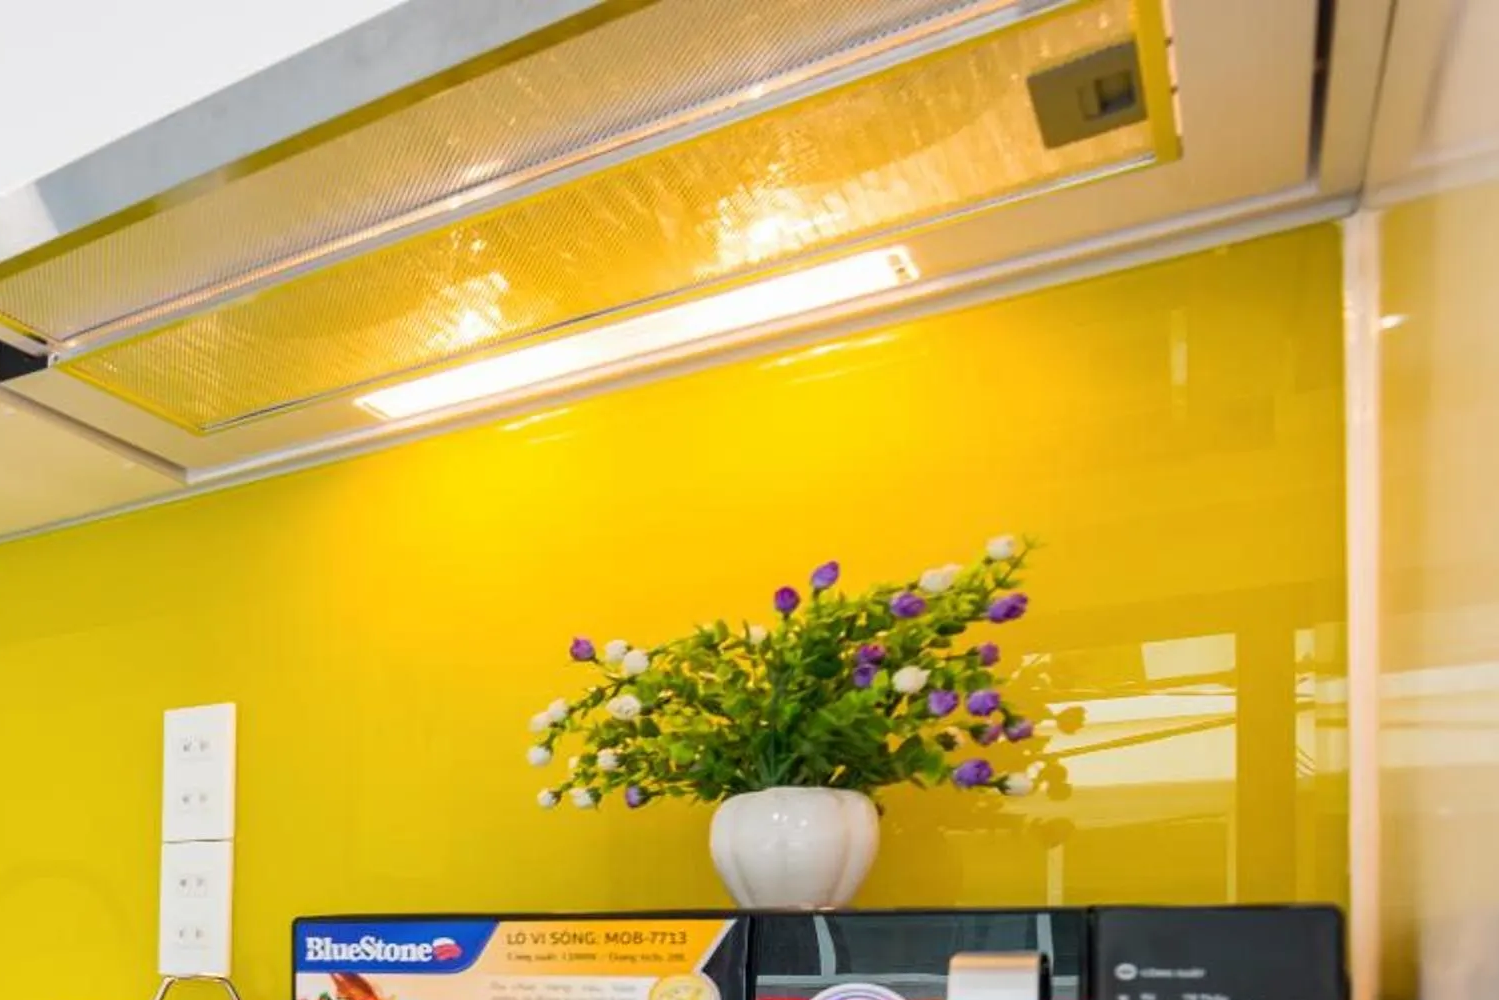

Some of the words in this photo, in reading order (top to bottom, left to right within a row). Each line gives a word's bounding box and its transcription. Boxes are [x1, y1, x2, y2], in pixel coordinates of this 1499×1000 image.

[531, 931, 546, 945] VI
[604, 931, 687, 945] MOB-7713
[305, 935, 433, 962] BlueStone
